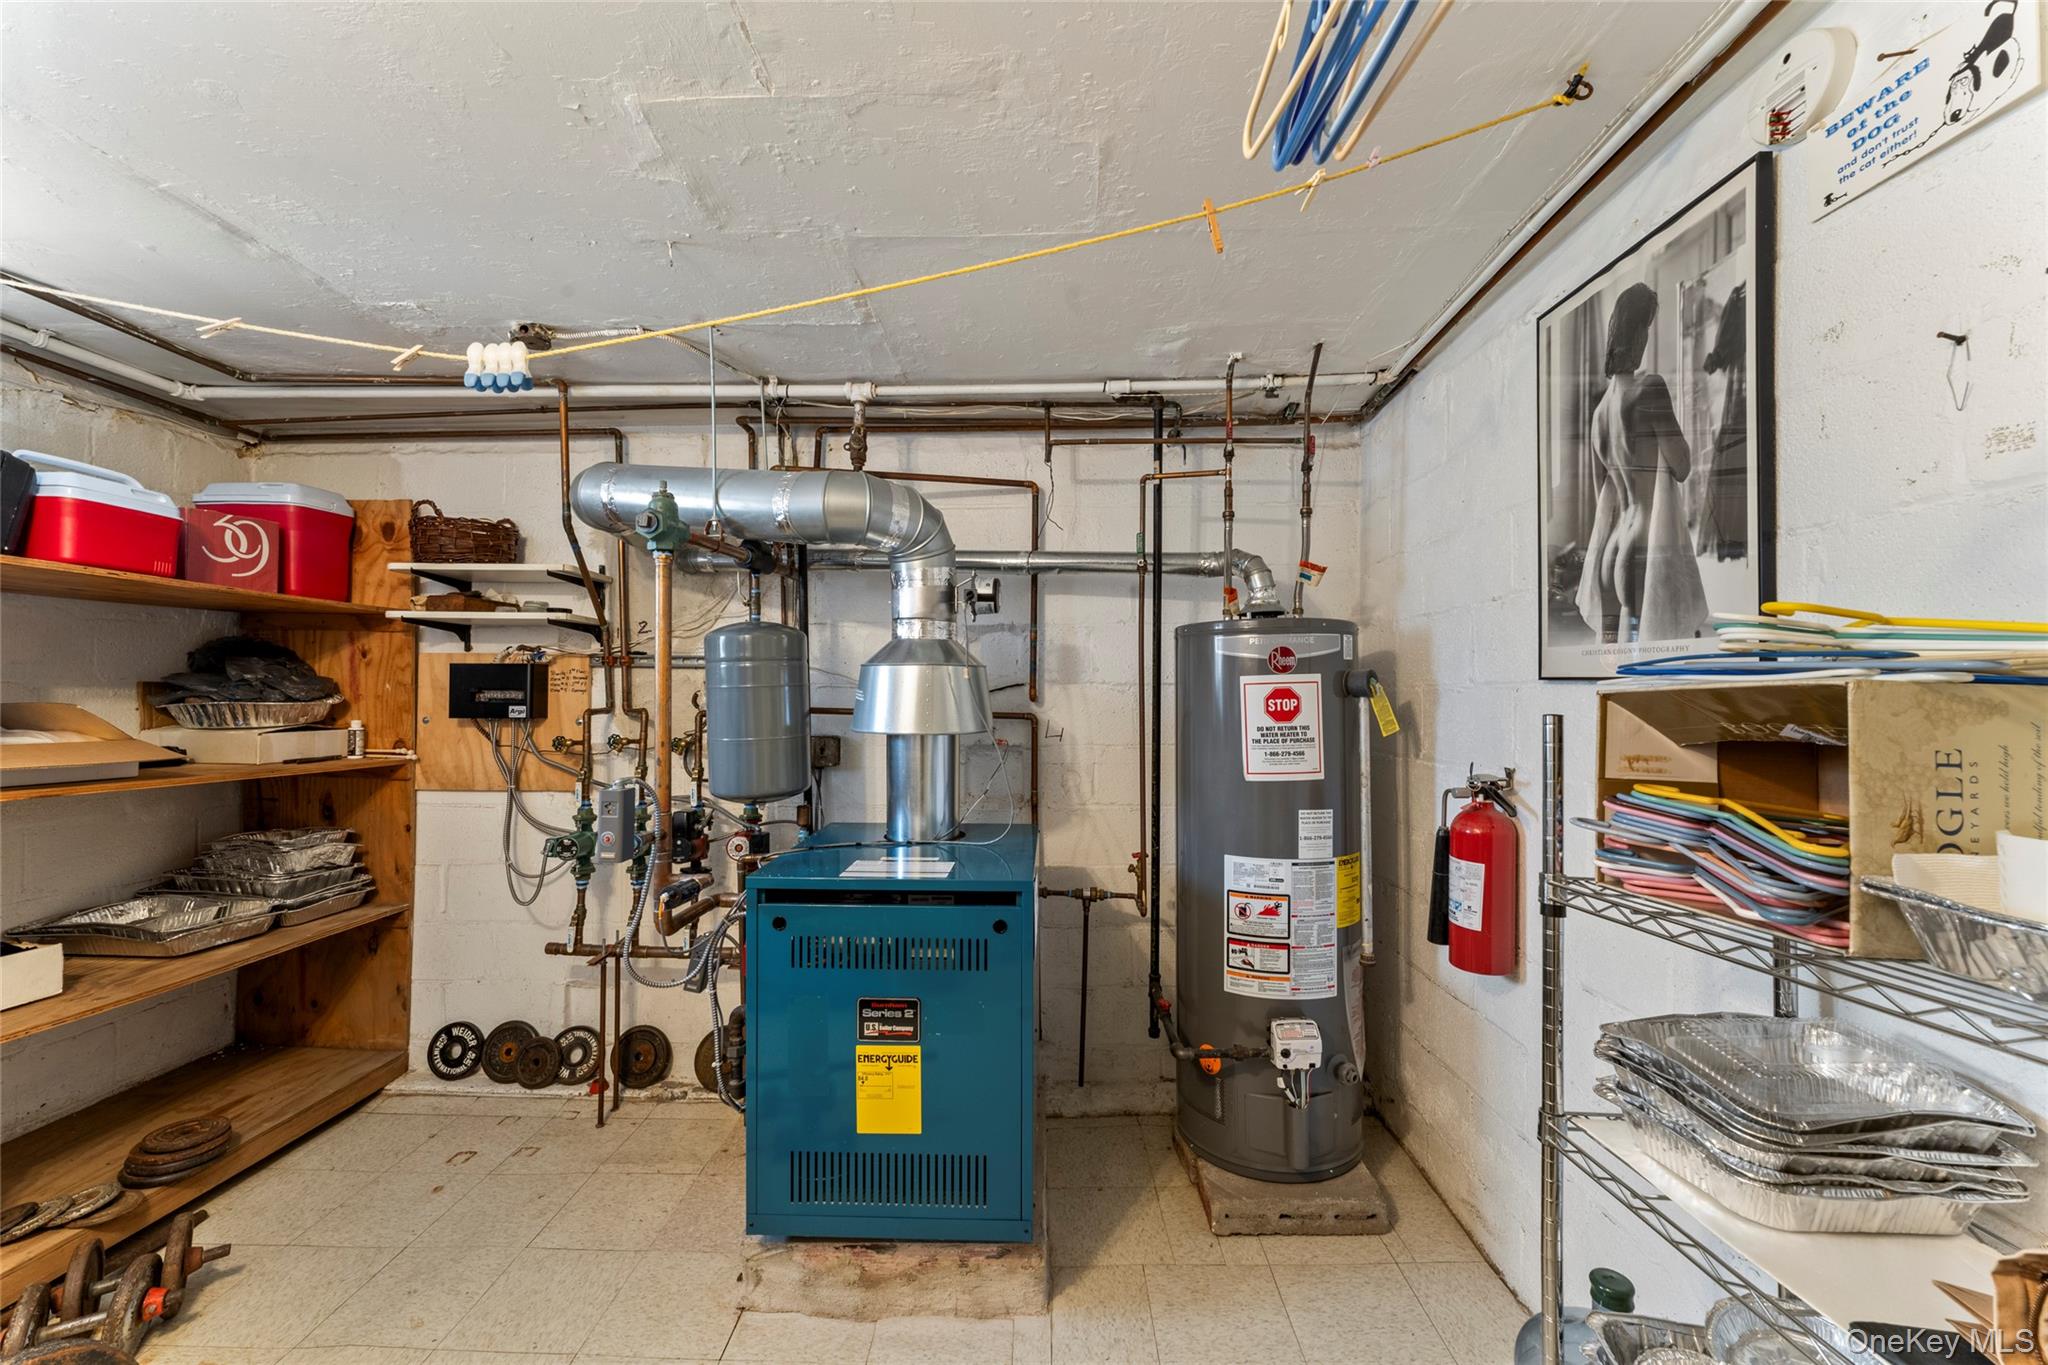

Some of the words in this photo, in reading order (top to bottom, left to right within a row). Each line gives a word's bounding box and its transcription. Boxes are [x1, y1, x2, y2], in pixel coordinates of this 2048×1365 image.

[1824, 57, 1930, 138] BEWARE
[1846, 119, 1868, 138] of
[1874, 89, 1912, 118] the
[1851, 113, 1901, 151] DOG
[1837, 156, 1858, 174] and
[1861, 136, 1888, 159] don't
[1892, 117, 1919, 139] trust
[1839, 171, 1856, 184] the
[1859, 156, 1876, 172] cat
[1880, 129, 1918, 159] either!
[638, 620, 652, 634] 2
[1271, 647, 1296, 672] Rheem
[1639, 644, 1690, 654] PHOTOGRAPHY
[1267, 698, 1298, 712] STOP
[1045, 719, 1065, 742] 4
[1997, 745, 2013, 768] high
[1998, 767, 2010, 793] hold
[862, 1008, 902, 1018] Series
[904, 1008, 914, 1018] 2
[451, 1026, 478, 1047] WEIDER
[433, 1048, 468, 1075] INTERNATIONAL
[857, 1054, 918, 1064] ENERGYGUIDE
